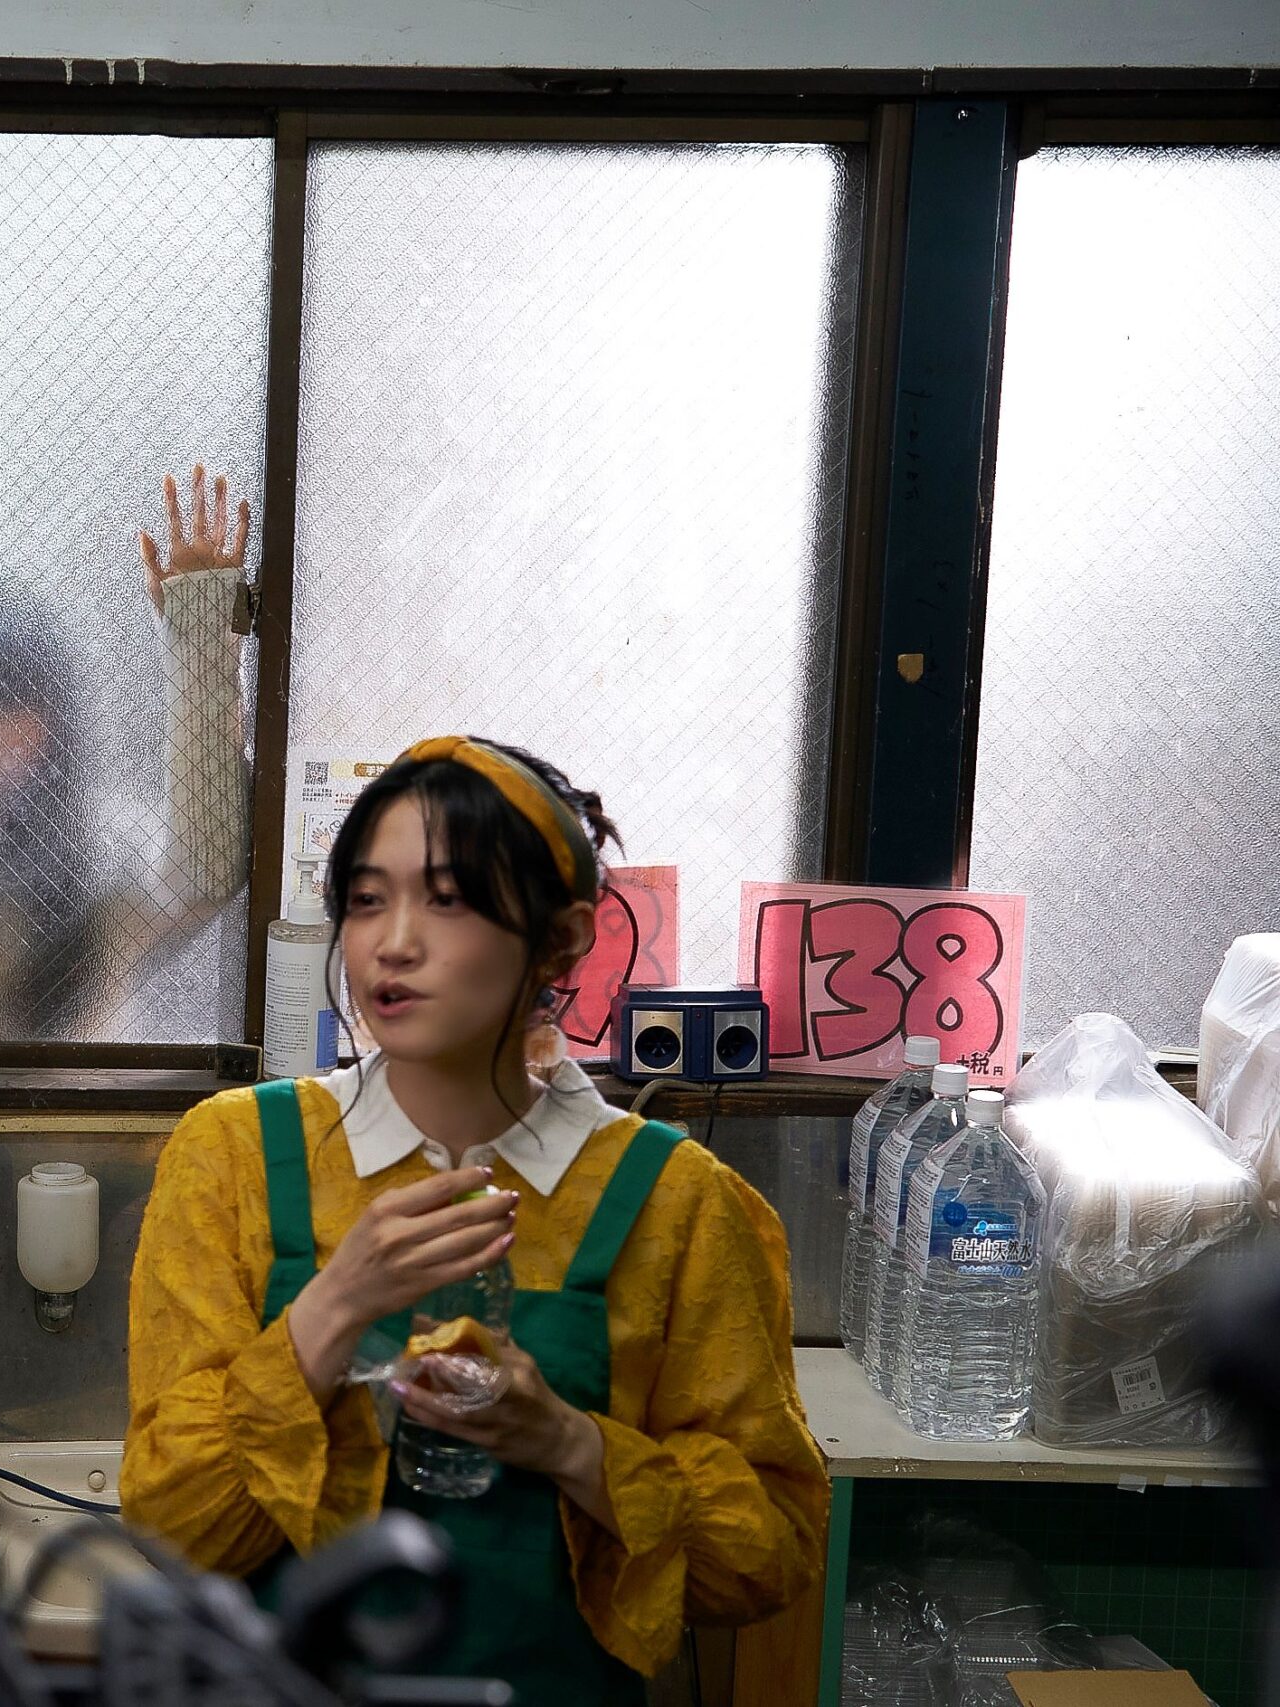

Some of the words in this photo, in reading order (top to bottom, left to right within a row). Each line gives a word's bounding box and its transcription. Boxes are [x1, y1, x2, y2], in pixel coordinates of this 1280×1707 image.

[755, 898, 1003, 1062] 138
[952, 1237, 1032, 1262] 富士山天然水
